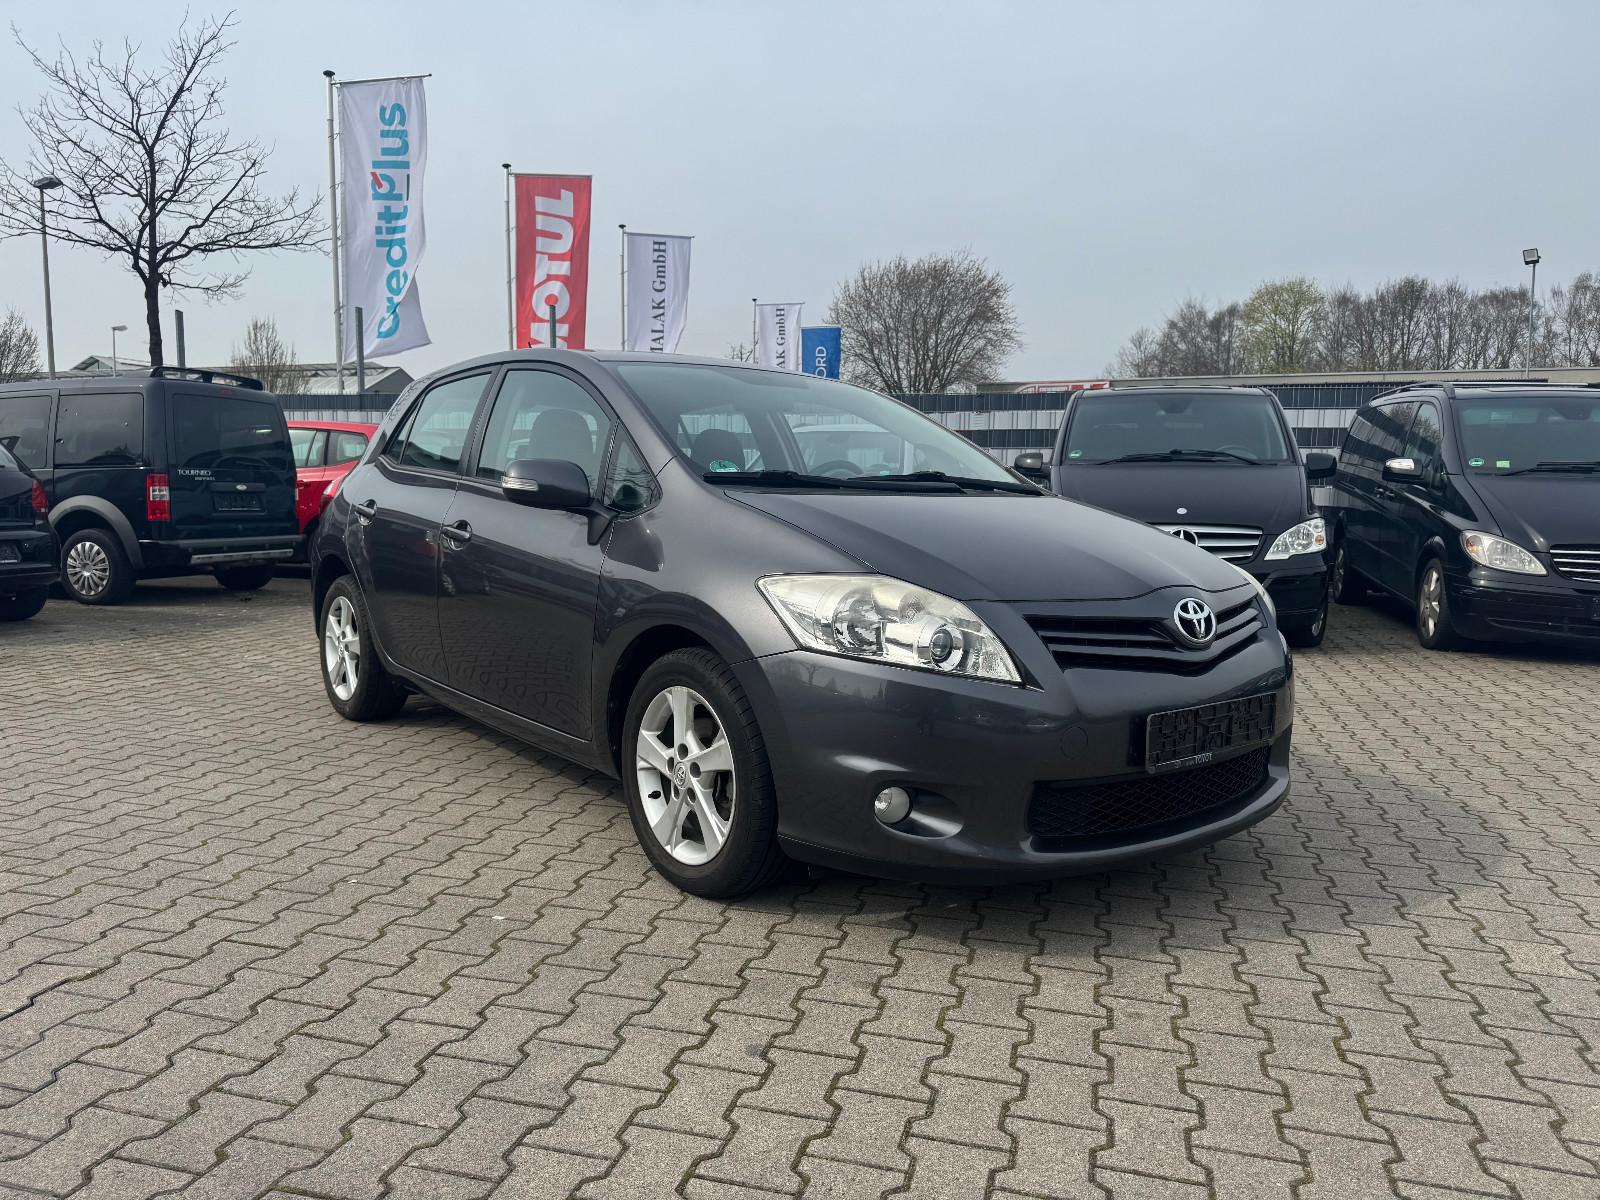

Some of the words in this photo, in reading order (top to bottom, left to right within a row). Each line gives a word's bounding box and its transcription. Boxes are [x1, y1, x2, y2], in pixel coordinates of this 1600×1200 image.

[652, 239, 667, 293] GmbH
[650, 298, 666, 352] ALAK
[775, 308, 786, 347] GmbH
